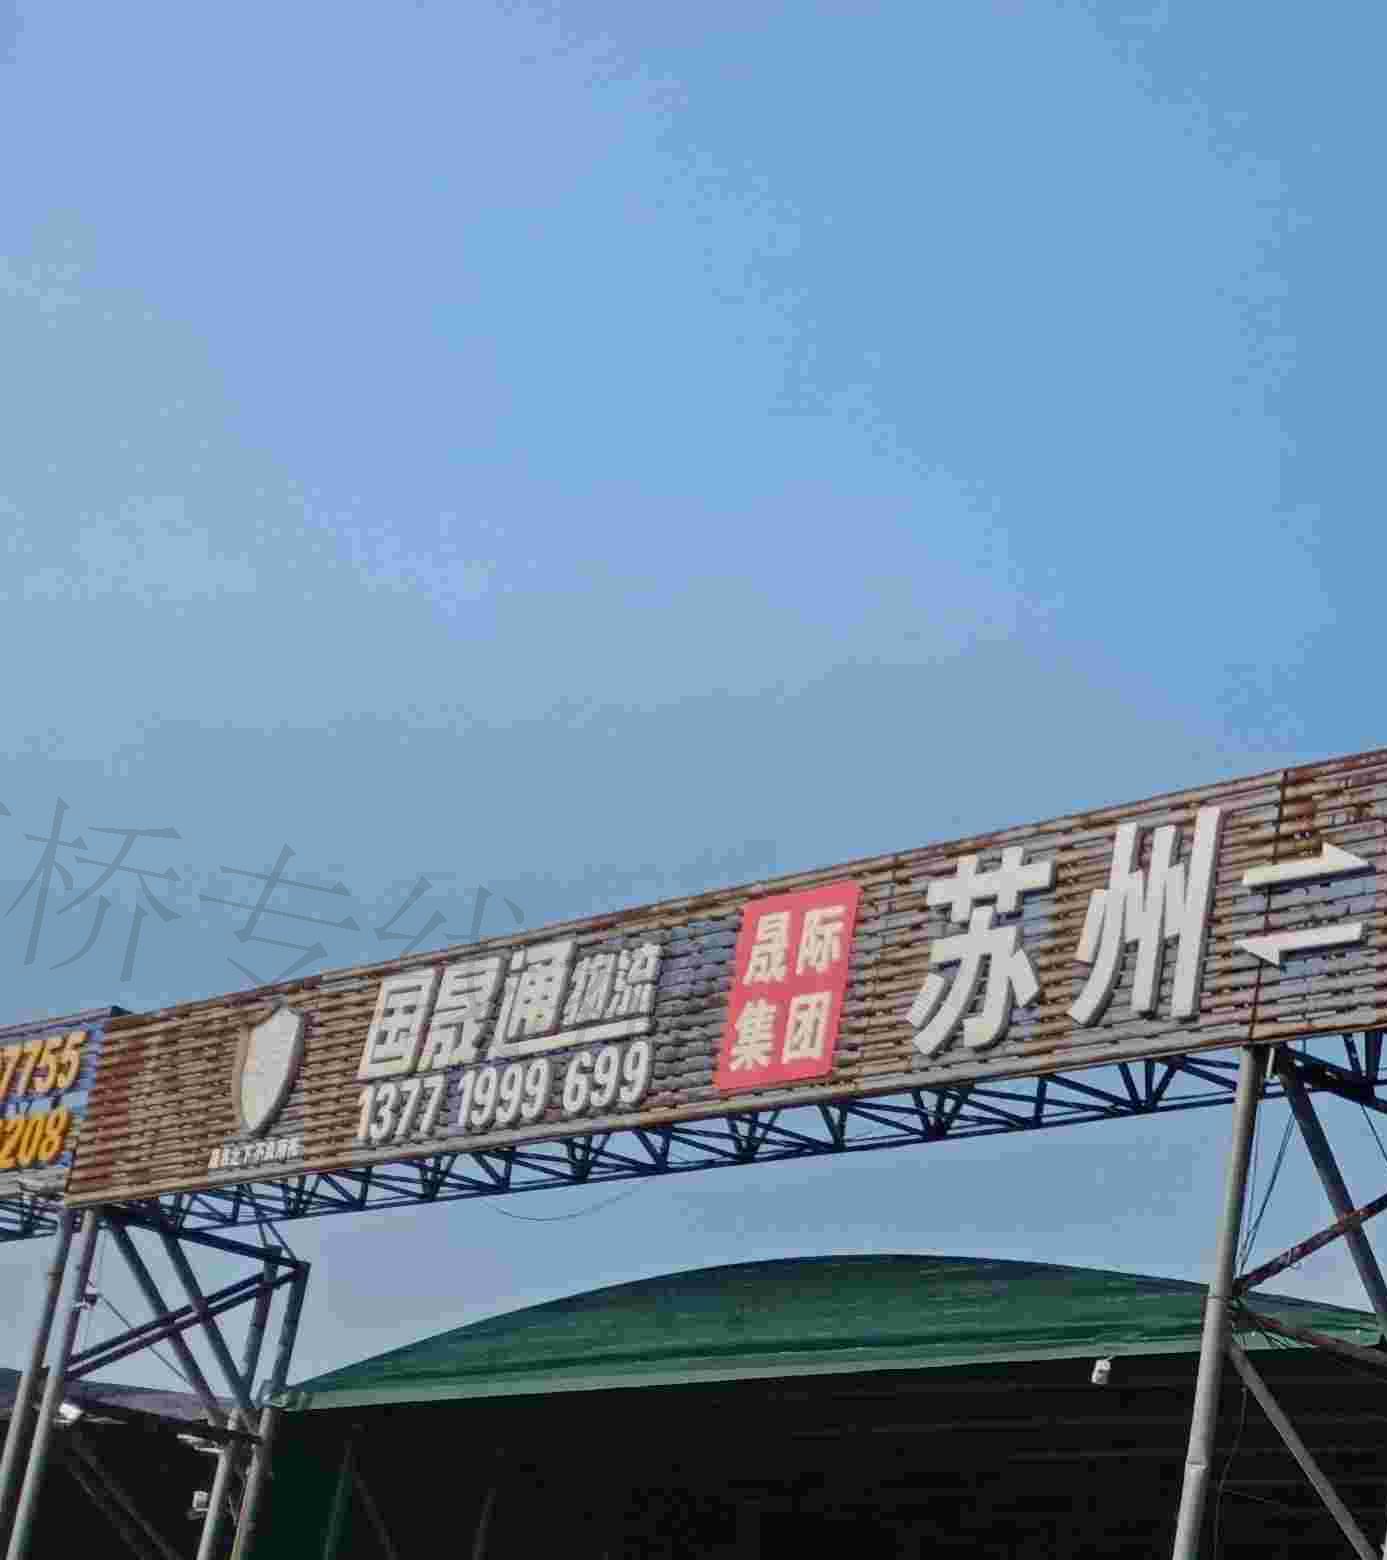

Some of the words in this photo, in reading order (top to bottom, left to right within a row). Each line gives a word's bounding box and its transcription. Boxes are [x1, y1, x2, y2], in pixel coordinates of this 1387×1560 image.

[729, 992, 832, 1072] 集团
[354, 1074, 443, 1144] 1377
[457, 1058, 549, 1130] 1999
[563, 1040, 653, 1115] 699
[0, 1103, 70, 1169] 208
